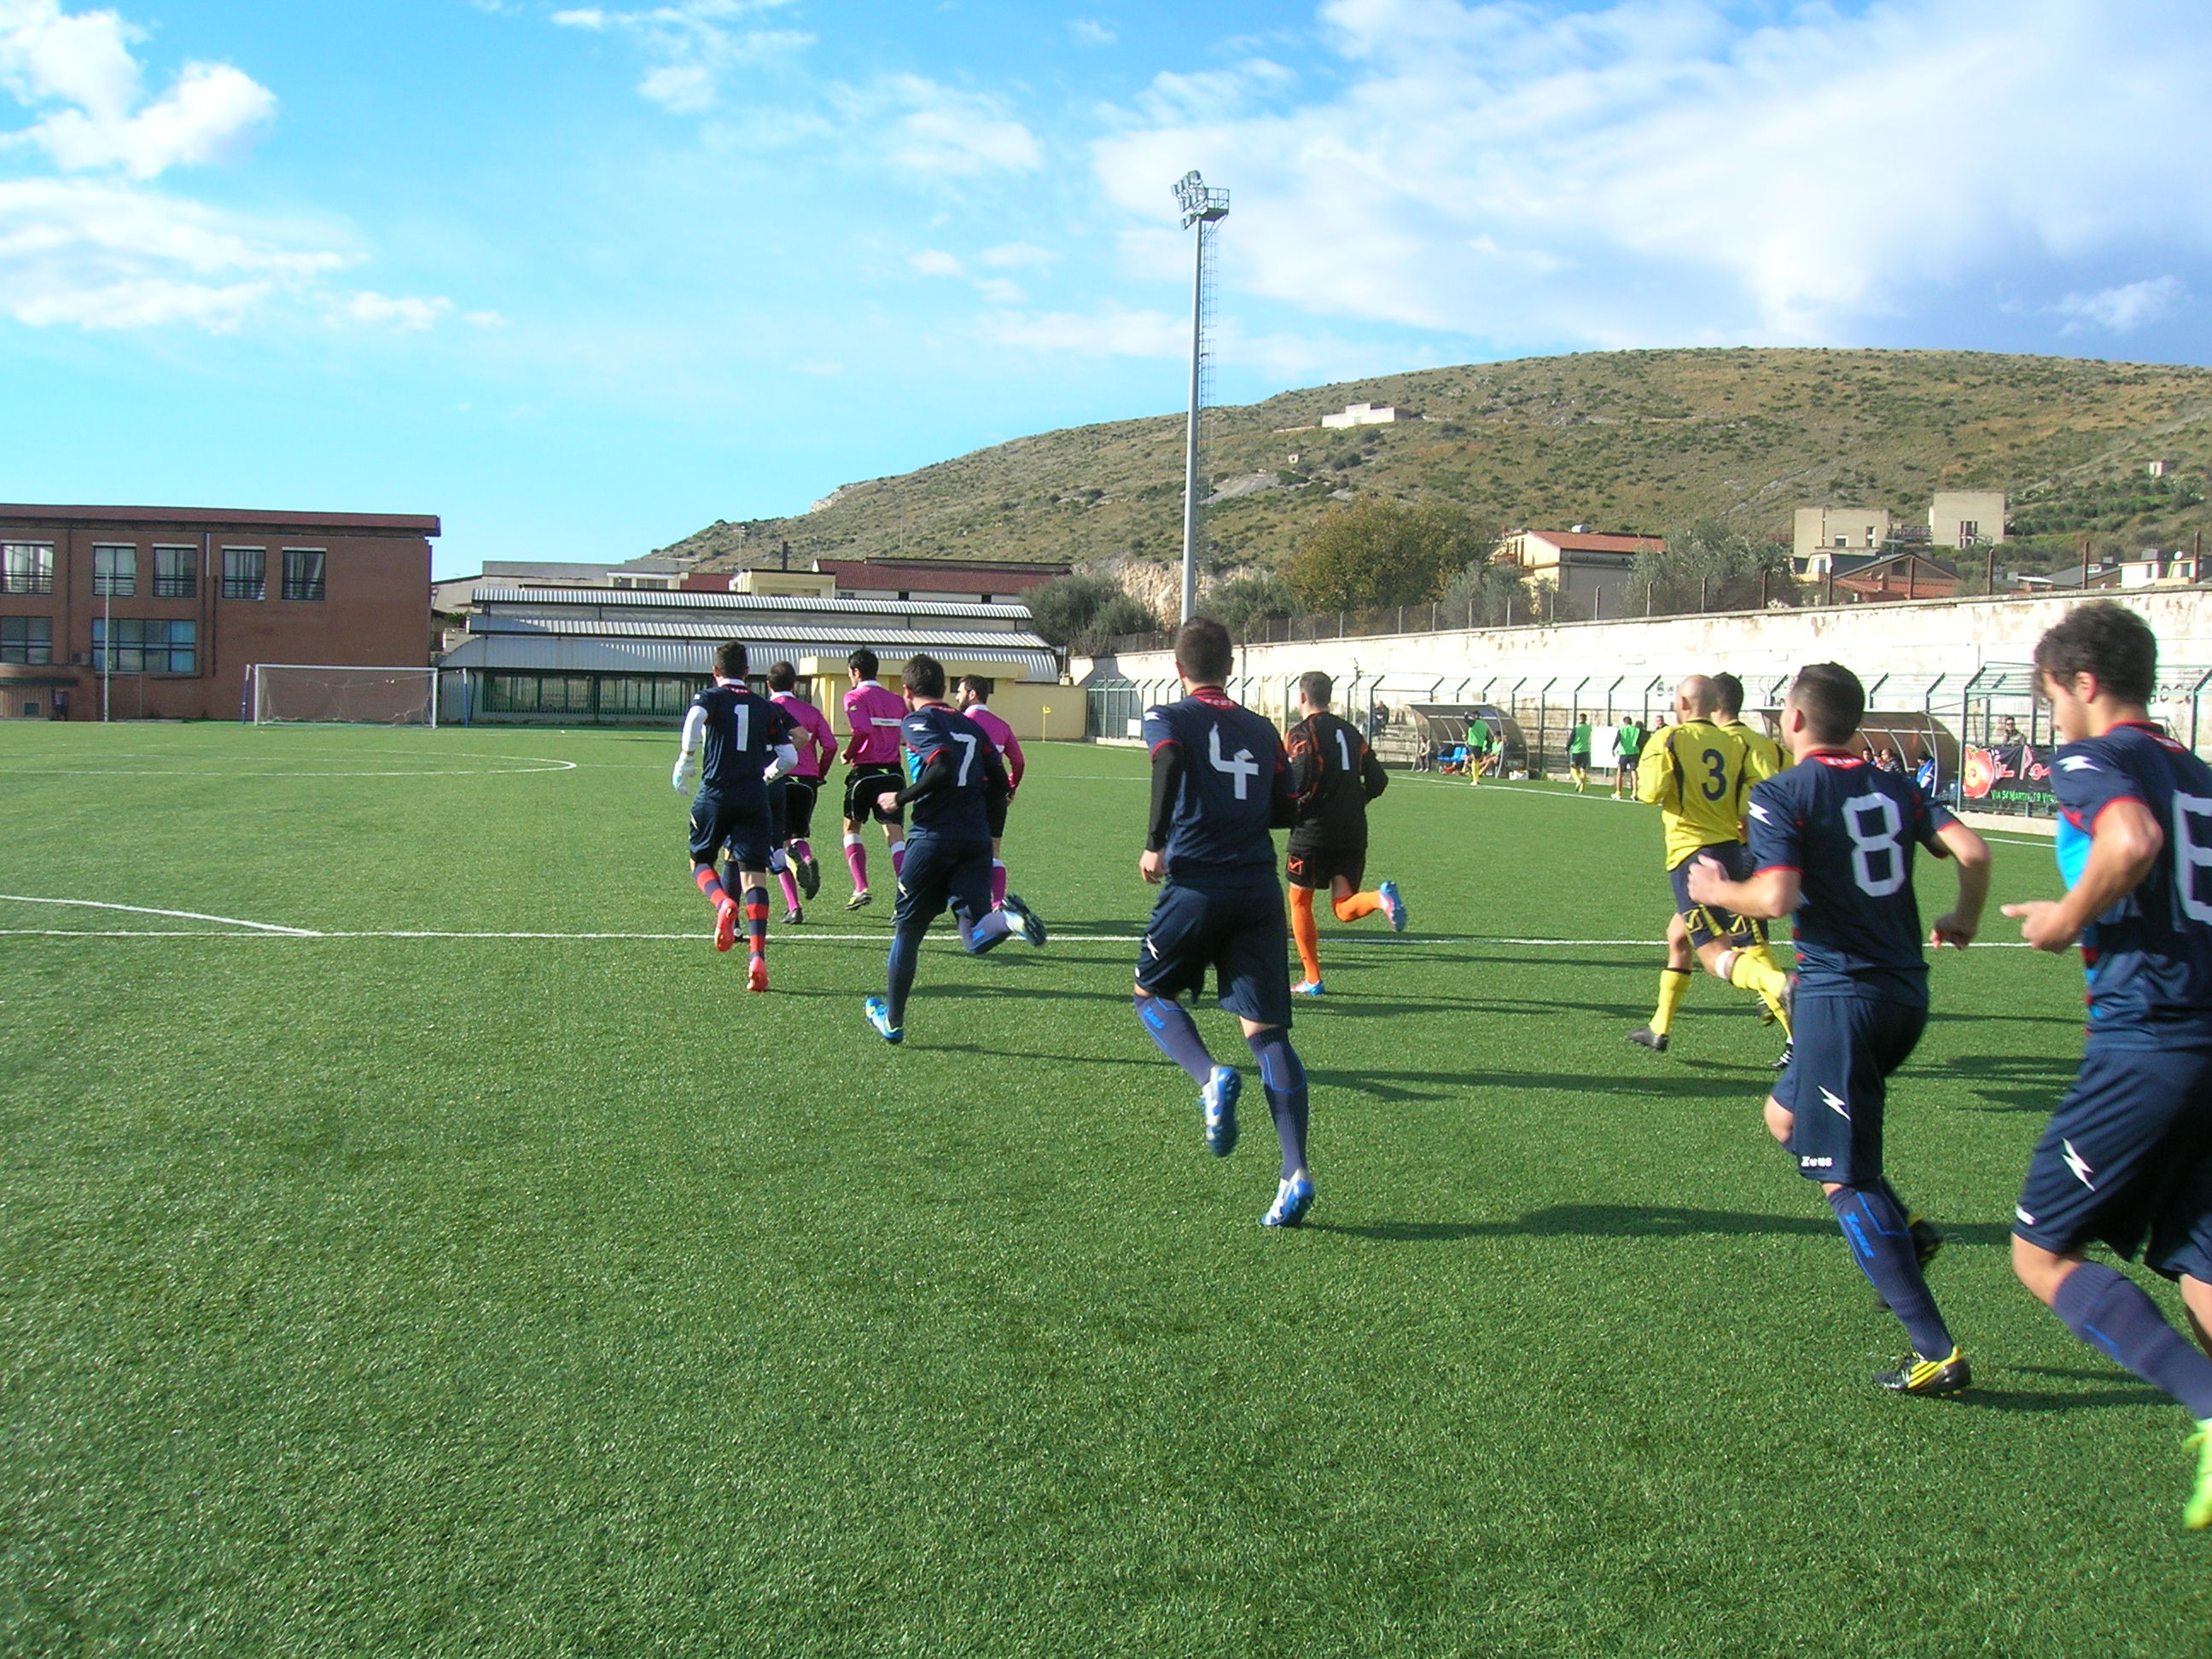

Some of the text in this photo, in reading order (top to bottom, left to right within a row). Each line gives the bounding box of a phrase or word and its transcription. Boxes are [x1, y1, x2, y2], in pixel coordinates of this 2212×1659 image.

[734, 704, 749, 751] 1
[1336, 729, 1350, 771] 1
[949, 731, 977, 787] 7
[1209, 721, 1259, 800] 4
[1701, 748, 1727, 801] 3
[1842, 793, 1905, 897] 8
[1801, 1155, 1833, 1167] Zeus
